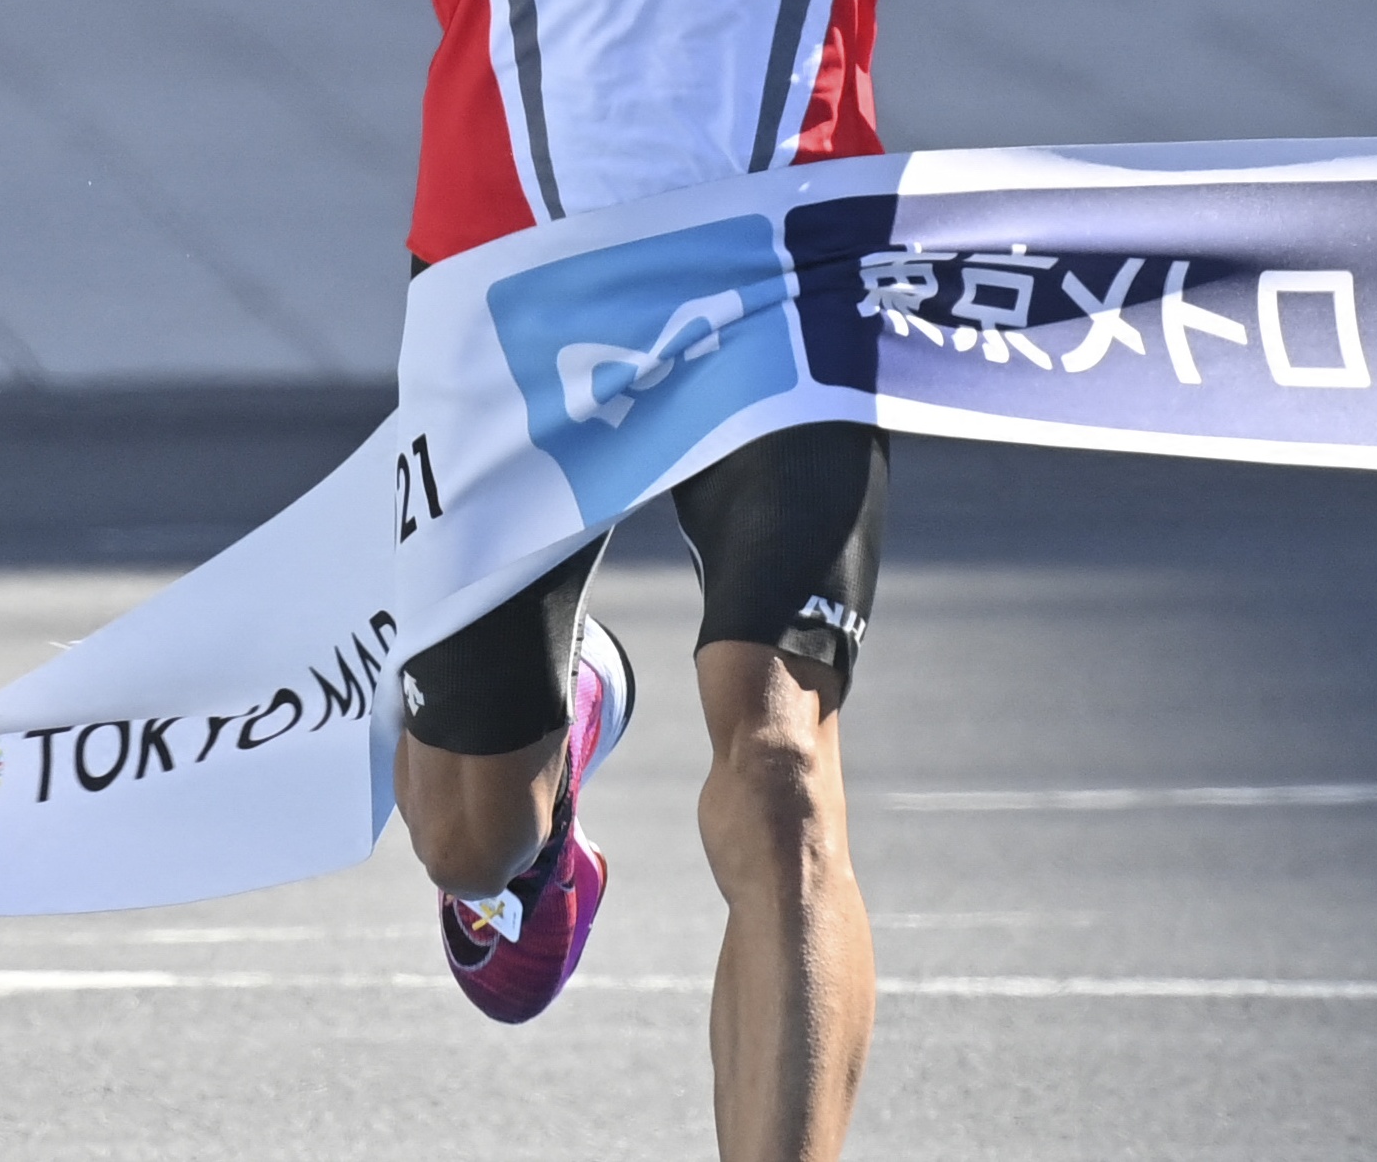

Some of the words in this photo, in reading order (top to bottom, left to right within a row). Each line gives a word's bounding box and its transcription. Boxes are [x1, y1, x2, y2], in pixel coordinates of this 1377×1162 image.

[855, 243, 1372, 389] 東京メトロ
[23, 687, 303, 803] TOKYO
